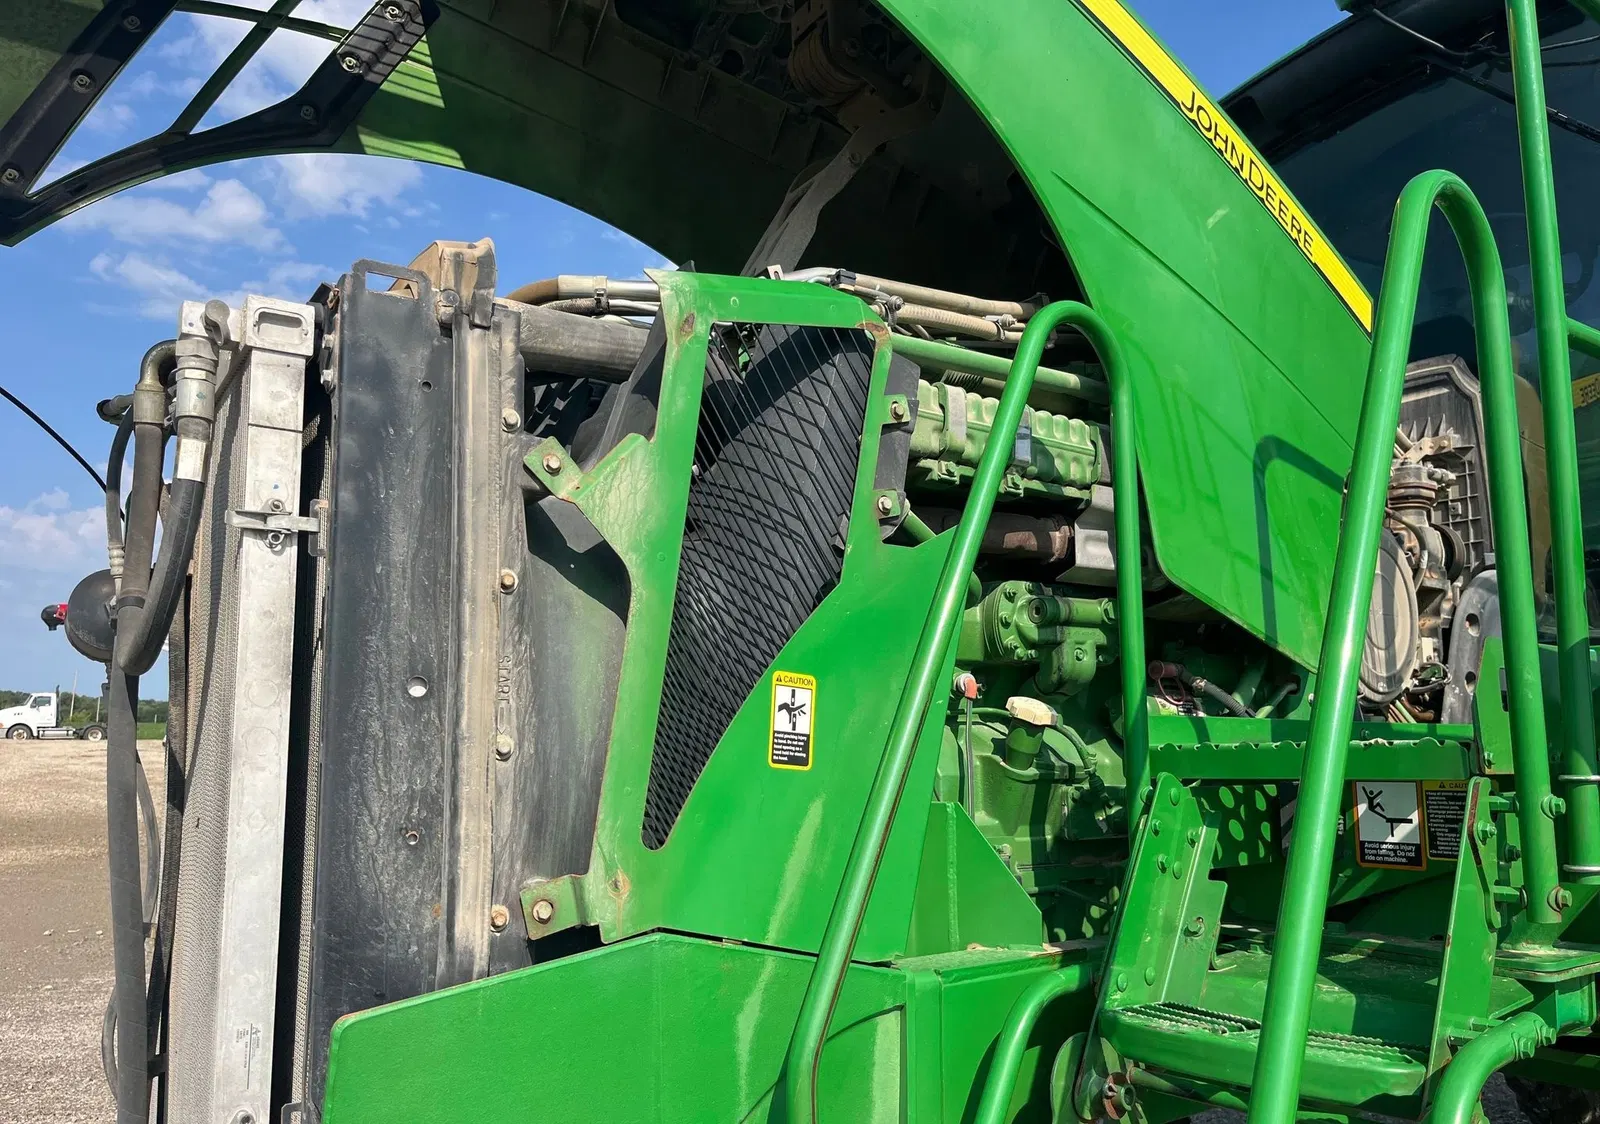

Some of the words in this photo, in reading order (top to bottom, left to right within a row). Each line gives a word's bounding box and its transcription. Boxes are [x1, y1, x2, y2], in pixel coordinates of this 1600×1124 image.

[1181, 90, 1245, 173] JOHN
[1249, 157, 1314, 257] DEERE
[784, 676, 814, 686] CAUTION
